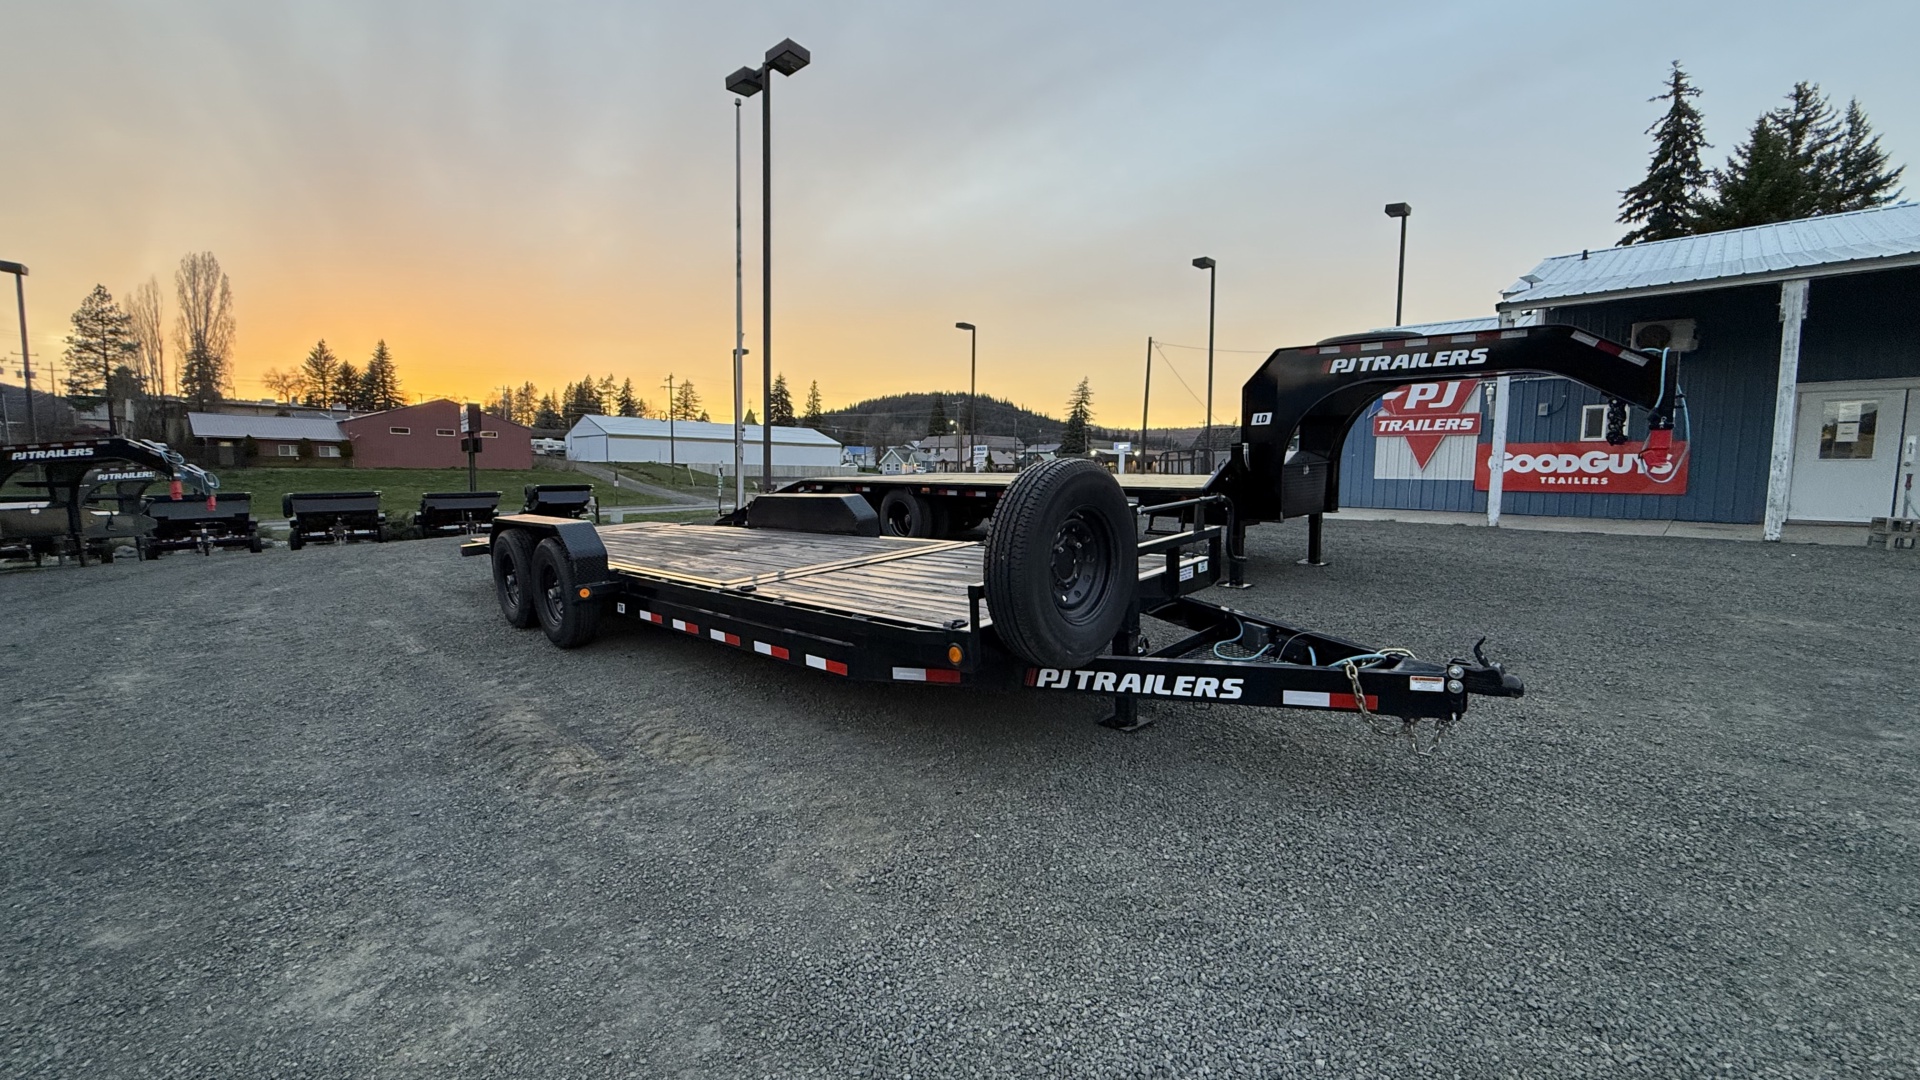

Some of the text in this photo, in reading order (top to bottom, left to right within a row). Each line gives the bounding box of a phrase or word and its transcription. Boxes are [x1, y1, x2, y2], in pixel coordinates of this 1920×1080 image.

[1329, 348, 1489, 374] PJ TRAILERS
[1403, 381, 1461, 410] PJ
[1256, 414, 1267, 423] LD
[1379, 418, 1475, 432] TRAILERS
[11, 447, 94, 461] PJ TRAILERS
[1540, 476, 1609, 485] TRAILERS
[1036, 668, 1245, 699] PJ TRAILERS
